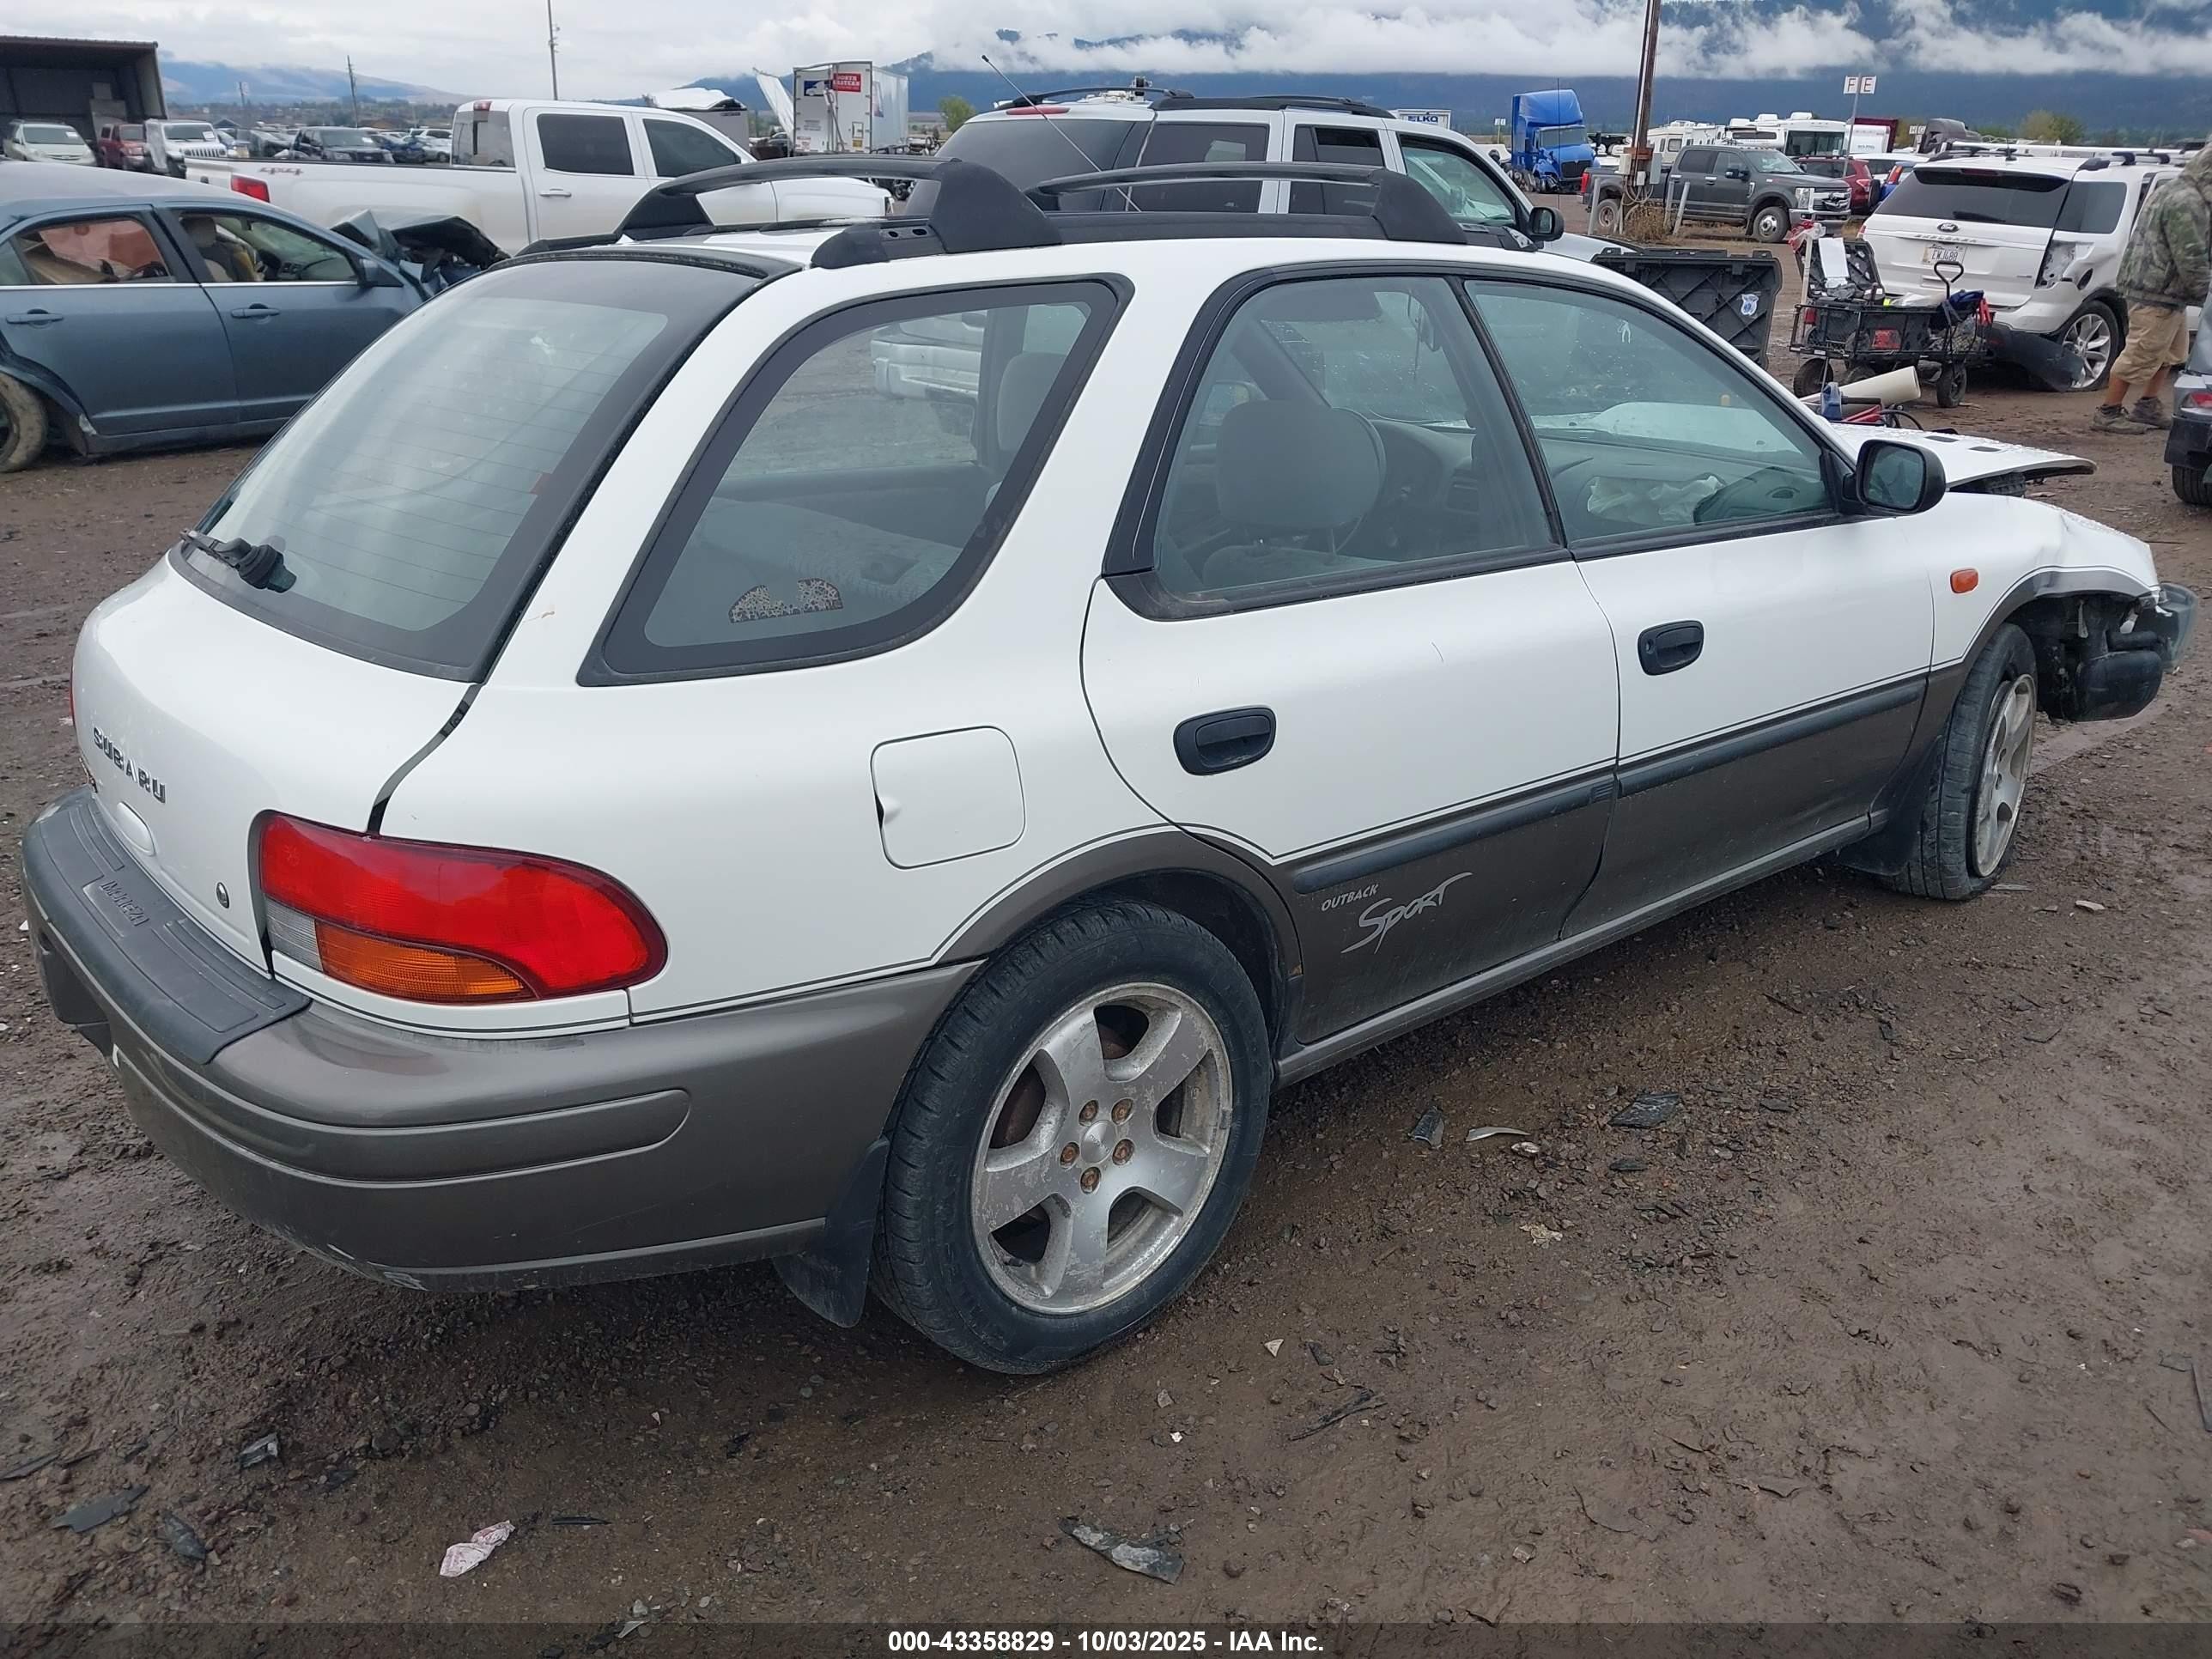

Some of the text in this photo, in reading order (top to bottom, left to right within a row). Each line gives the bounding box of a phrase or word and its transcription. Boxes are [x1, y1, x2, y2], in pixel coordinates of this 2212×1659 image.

[1848, 77, 1856, 92] F
[1863, 77, 1873, 92] E
[1416, 115, 1439, 124] LKQ
[93, 726, 165, 804] SUBARU
[1321, 884, 1379, 912] OUTBACK
